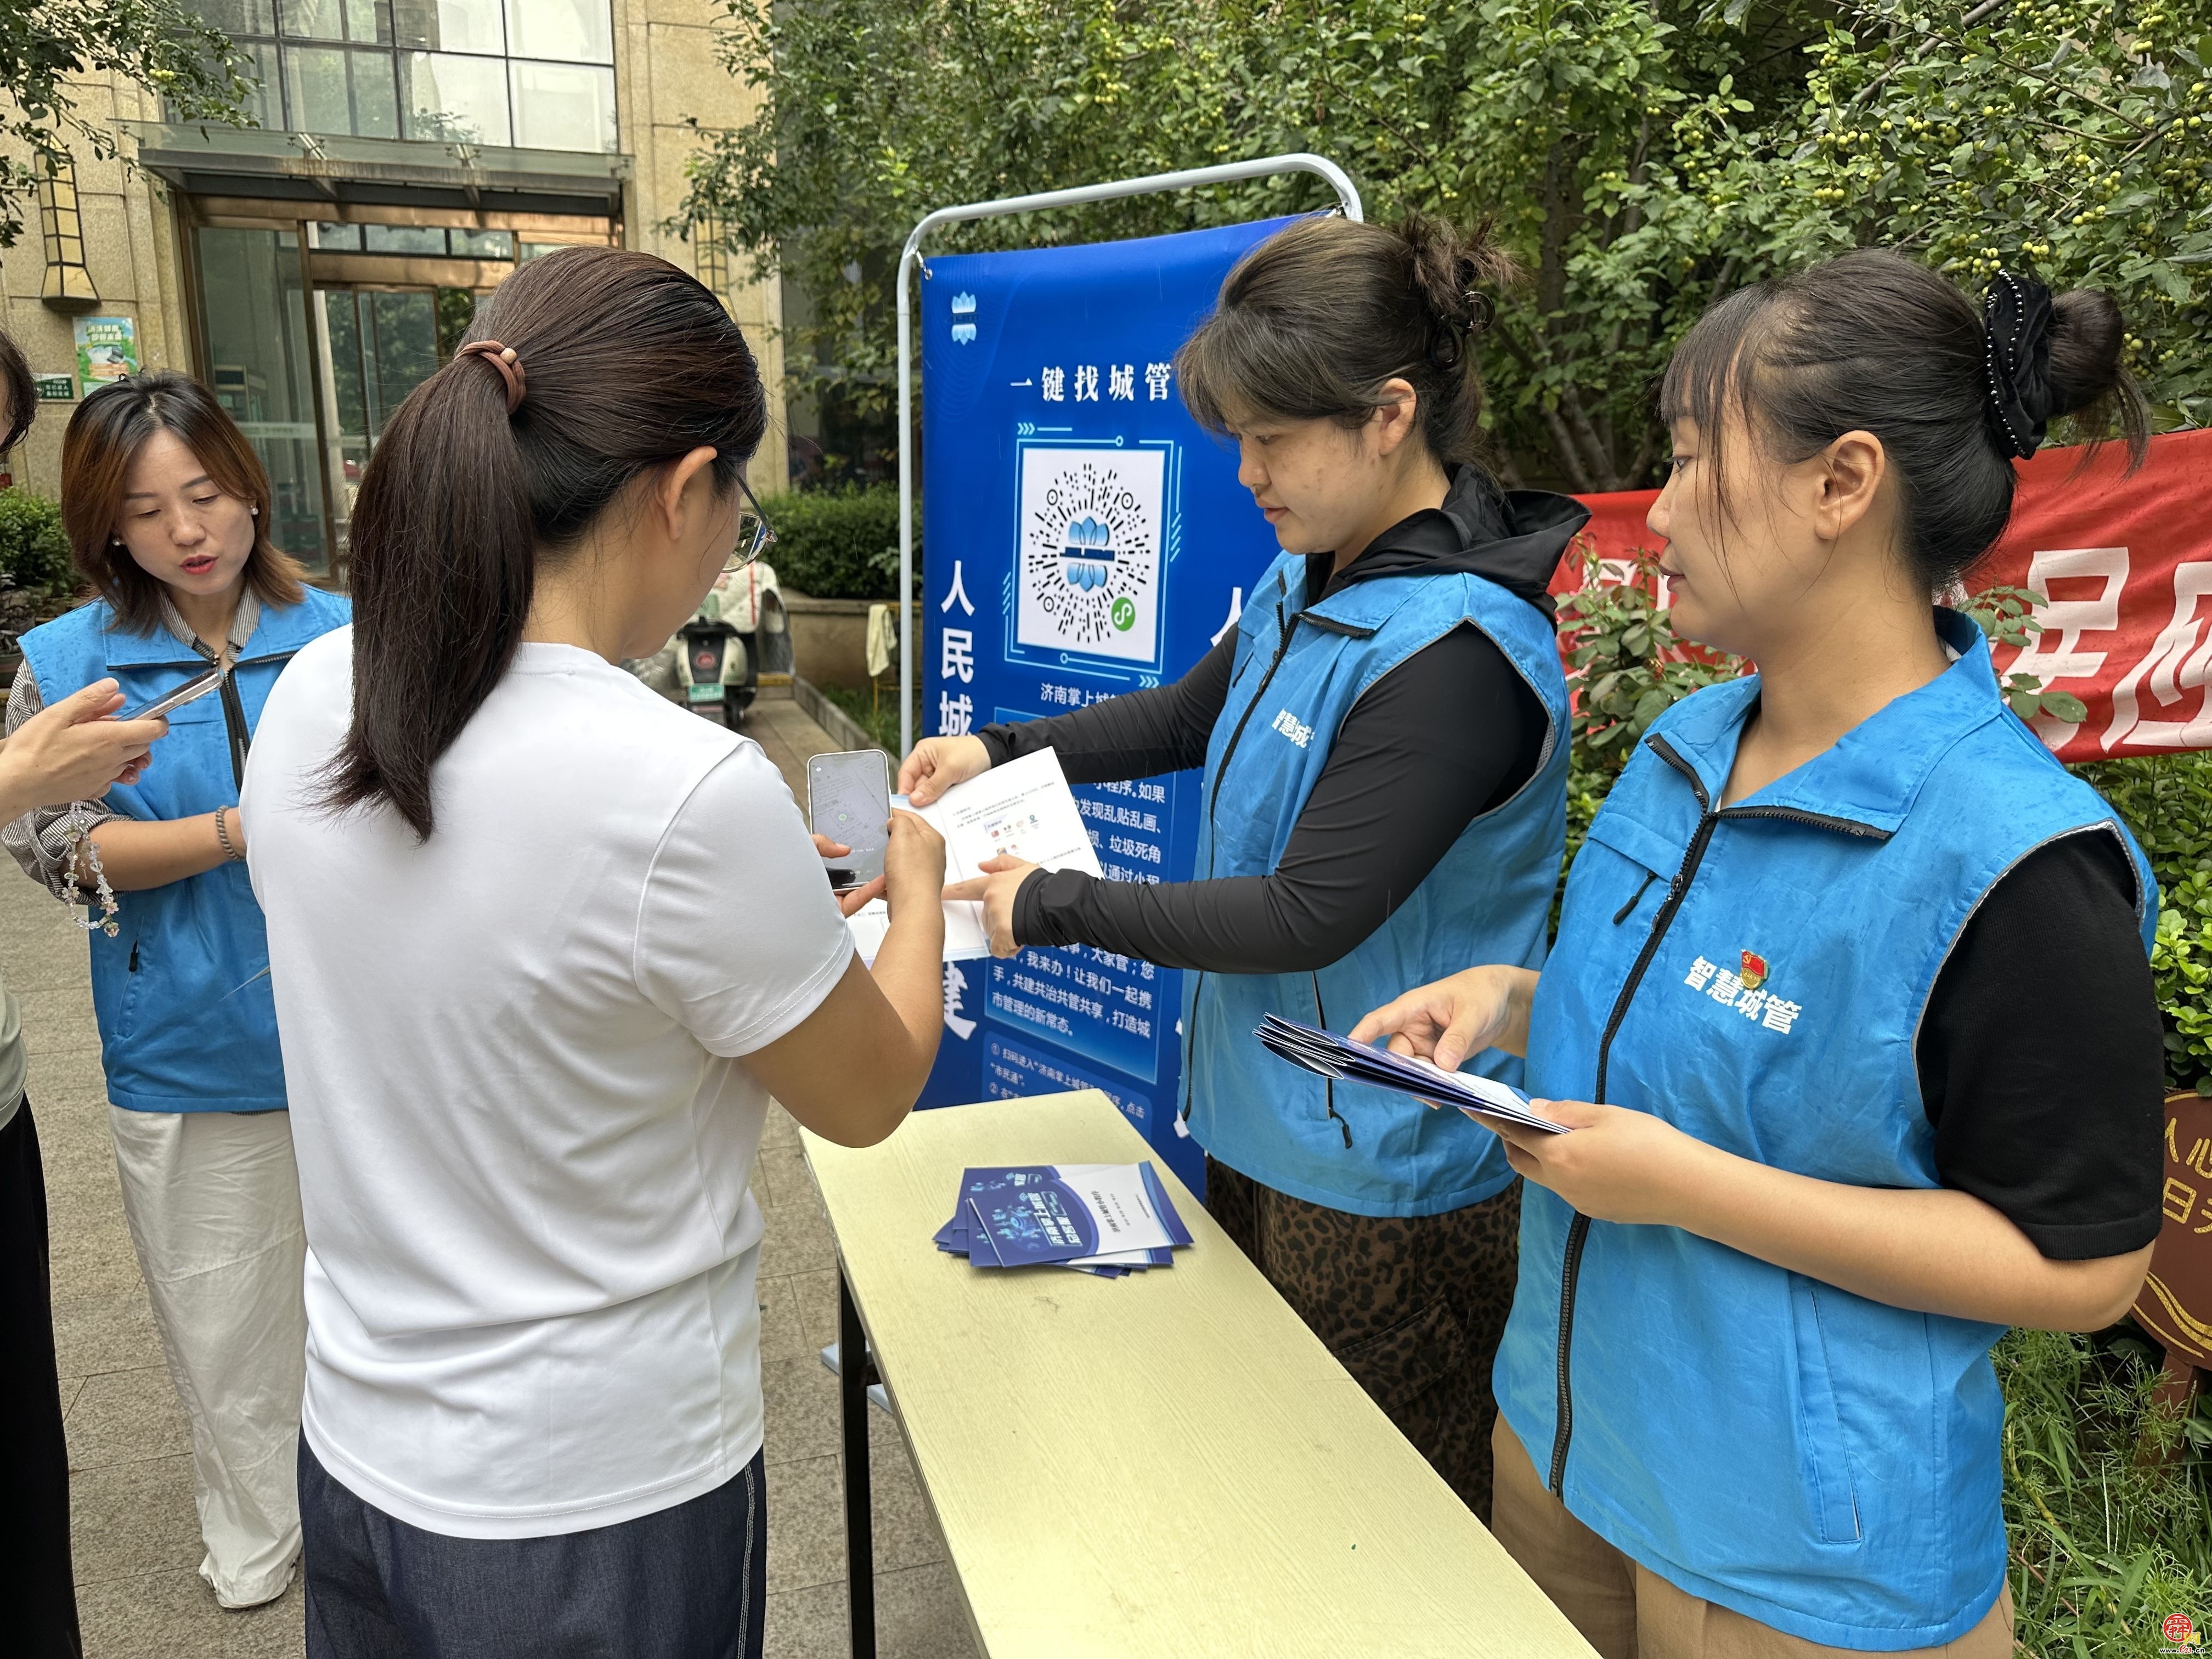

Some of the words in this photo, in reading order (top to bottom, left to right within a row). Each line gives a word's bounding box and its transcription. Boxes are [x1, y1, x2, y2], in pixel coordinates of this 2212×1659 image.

[1010, 362, 1172, 403] 一键找城管
[1040, 682, 1117, 708] 济南掌上城
[1683, 955, 1803, 1035] 智慧城管
